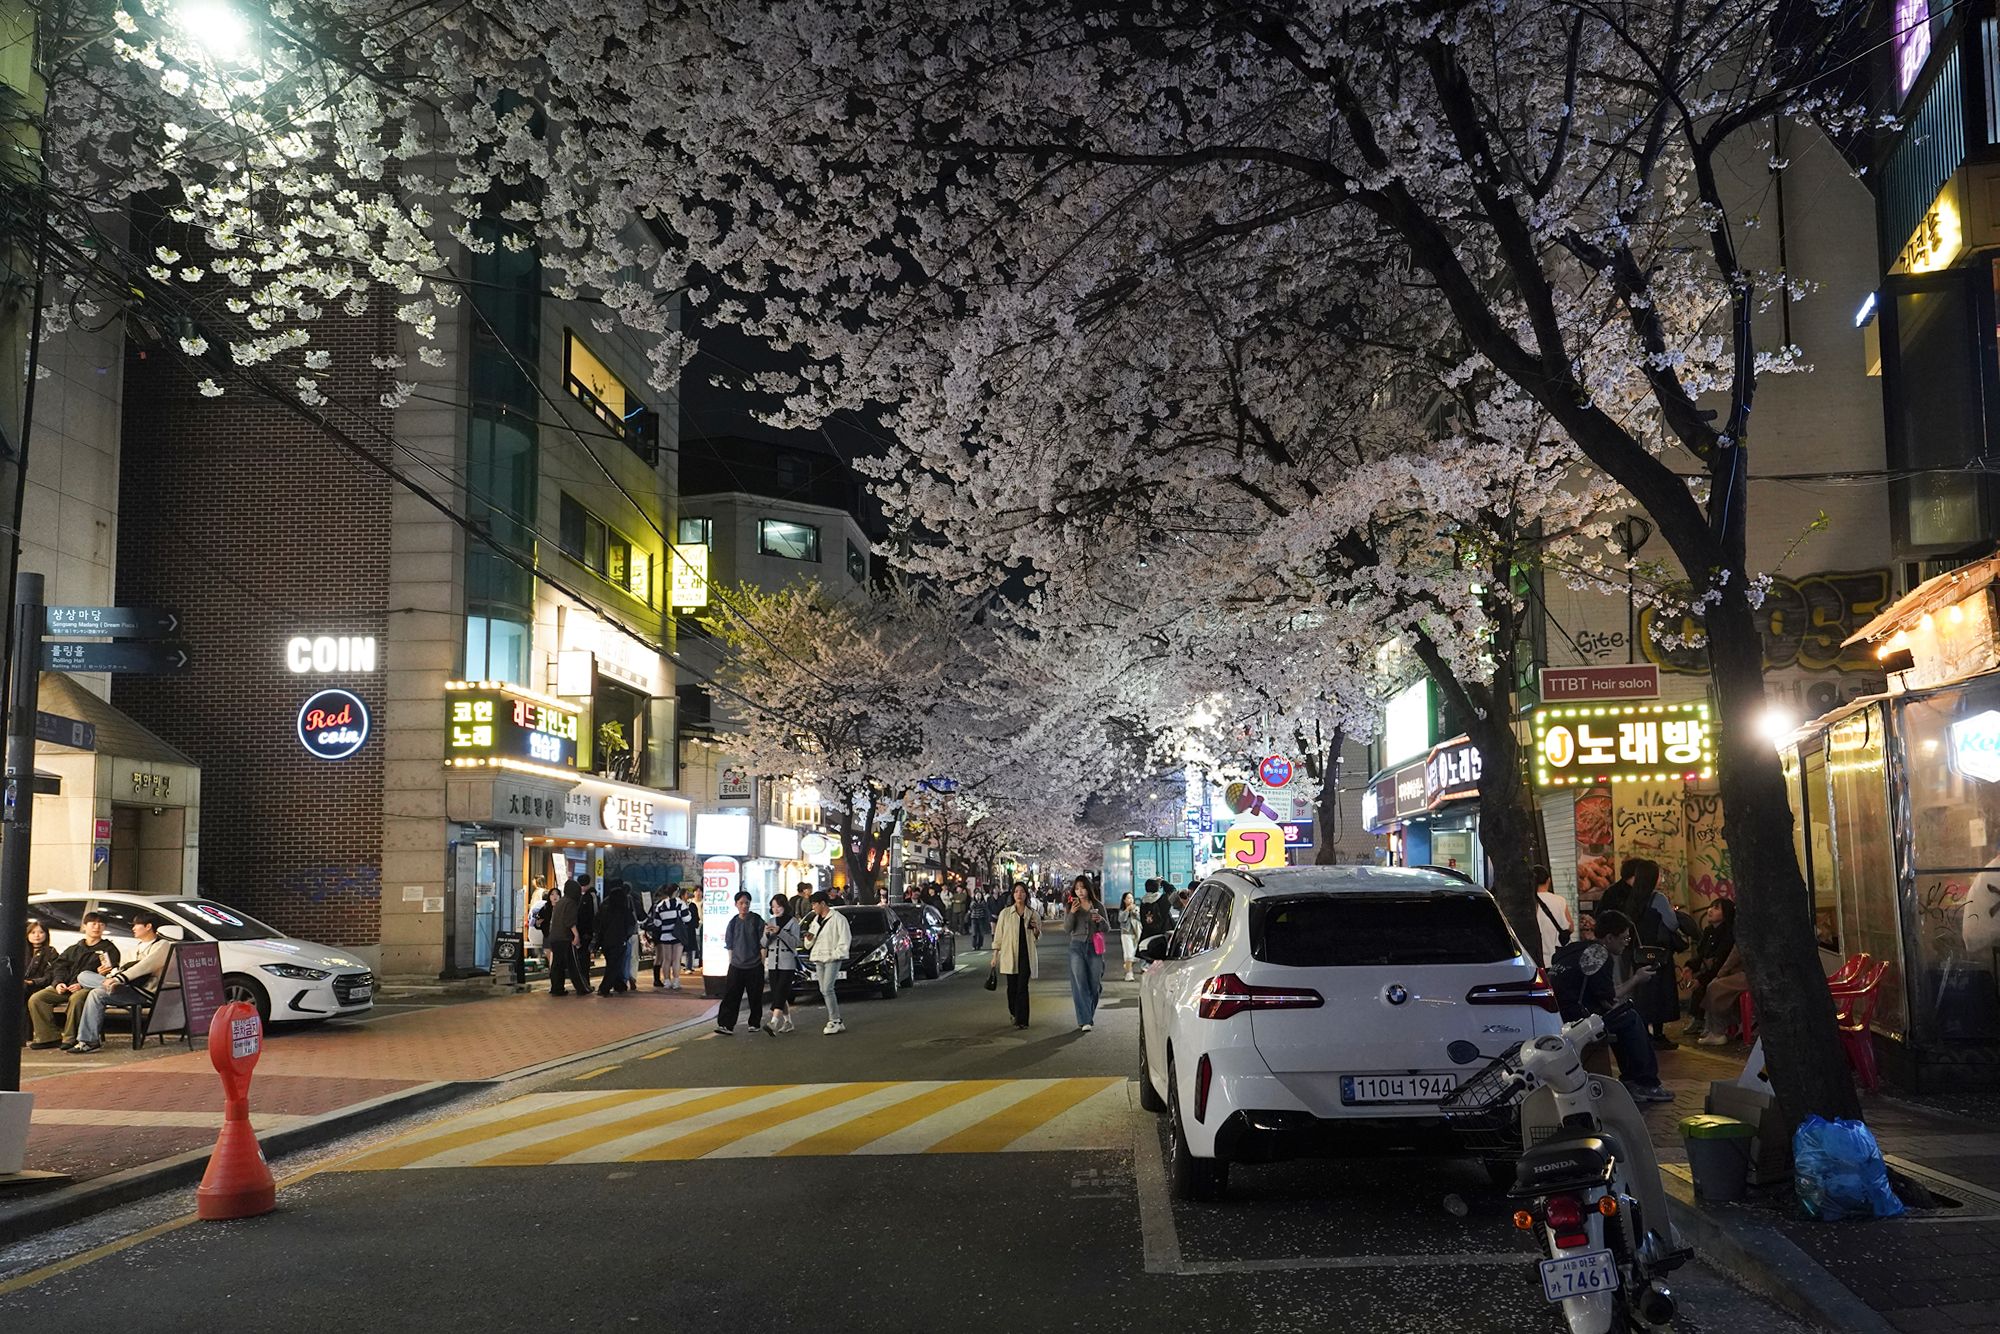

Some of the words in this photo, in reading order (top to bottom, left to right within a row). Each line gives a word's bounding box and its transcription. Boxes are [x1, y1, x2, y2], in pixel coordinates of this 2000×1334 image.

[52, 610, 102, 621] 상상마당
[51, 645, 85, 657] 롤링홀
[287, 636, 375, 673] COIN
[1548, 677, 1588, 692] TTBT
[1592, 679, 1616, 690] Hair
[1618, 678, 1652, 689] salon
[305, 703, 352, 731] Red
[453, 701, 492, 721] 코인
[318, 726, 360, 745] coin
[452, 725, 492, 747] 노래
[1550, 733, 1568, 763] J
[1577, 720, 1703, 765] 노래방
[133, 772, 171, 798] 평화빌딩
[1296, 808, 1306, 817] 3F
[1235, 831, 1271, 864] J
[704, 876, 729, 888] RED
[233, 1022, 258, 1038] 주차금지
[1357, 1079, 1404, 1098] 110너
[1409, 1078, 1453, 1097] 1944
[1533, 1160, 1579, 1174] HONDA
[1579, 1257, 1597, 1269] 마포
[1551, 1282, 1562, 1293] 카
[1563, 1267, 1611, 1293] 7461
